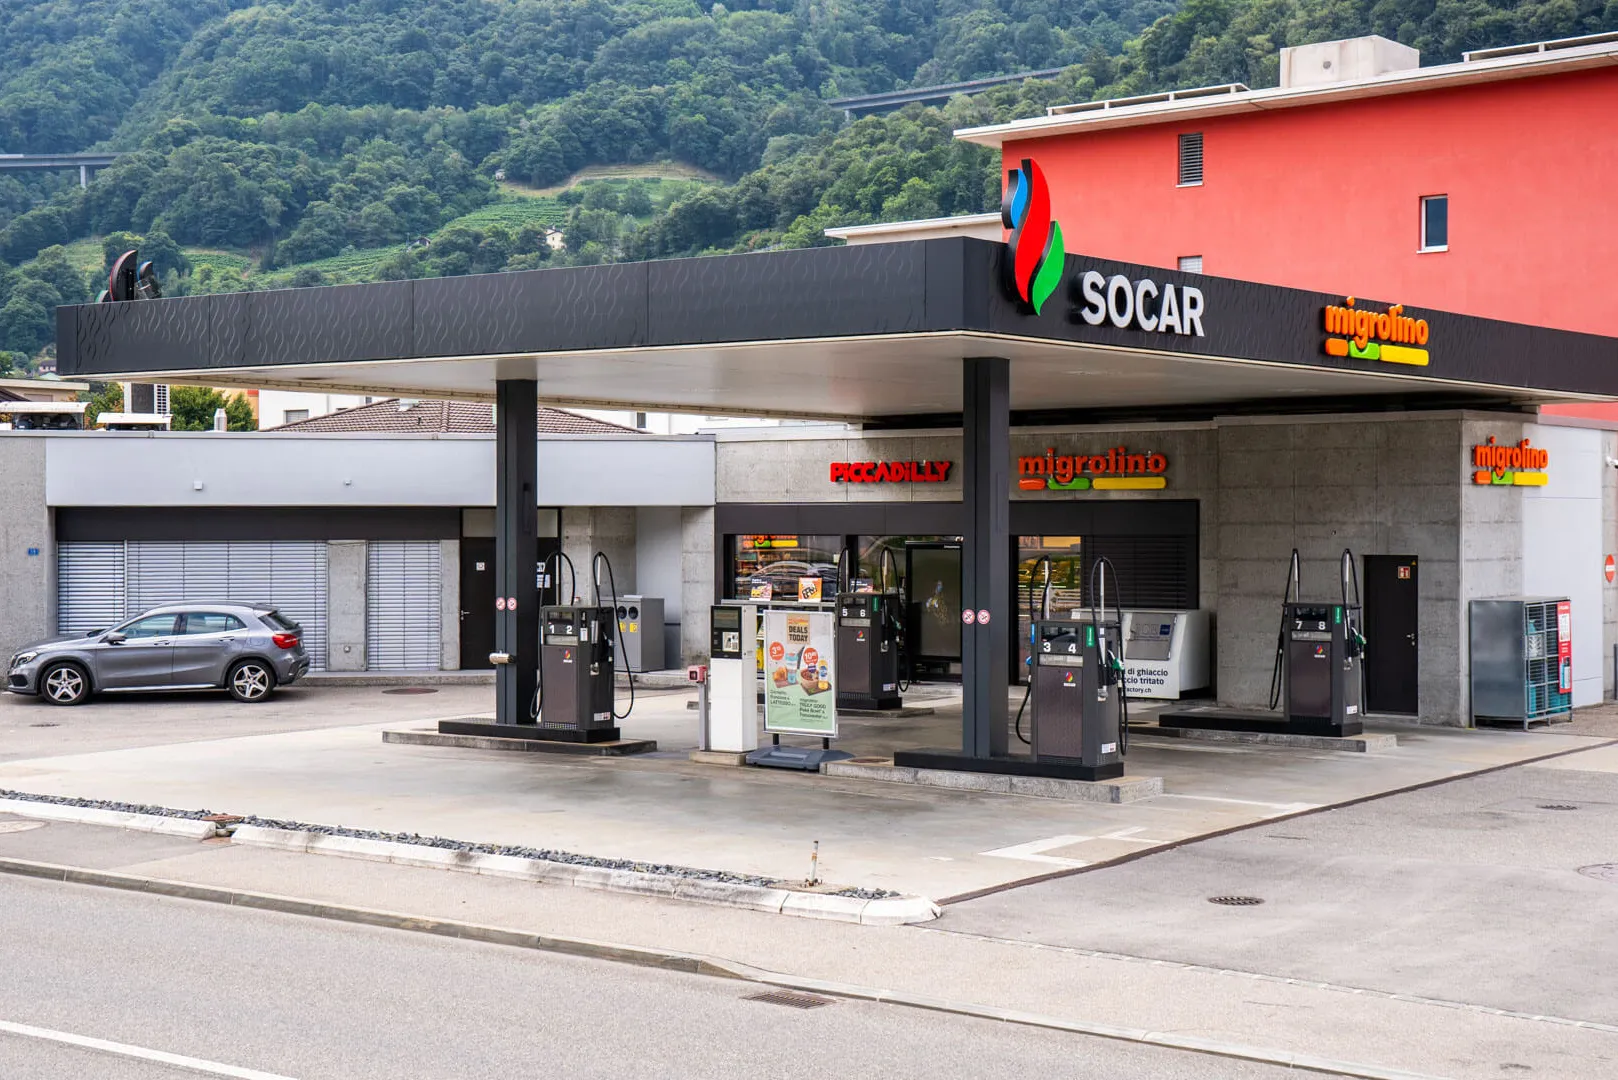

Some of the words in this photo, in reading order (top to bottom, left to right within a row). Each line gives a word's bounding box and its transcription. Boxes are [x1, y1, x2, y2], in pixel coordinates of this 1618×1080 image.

[1079, 270, 1206, 338] SOCAR
[1325, 295, 1430, 349] migrolino
[1473, 435, 1549, 477] migrolino
[1018, 446, 1168, 482] migrolino
[549, 625, 555, 633] 1
[566, 625, 572, 634] 2
[1296, 621, 1302, 630] 7
[1318, 622, 1326, 630] 8
[1043, 642, 1051, 652] 3
[1068, 643, 1076, 653] 4
[1127, 667, 1135, 675] di
[1136, 668, 1168, 677] ghiaccio
[1140, 677, 1165, 685] tritato
